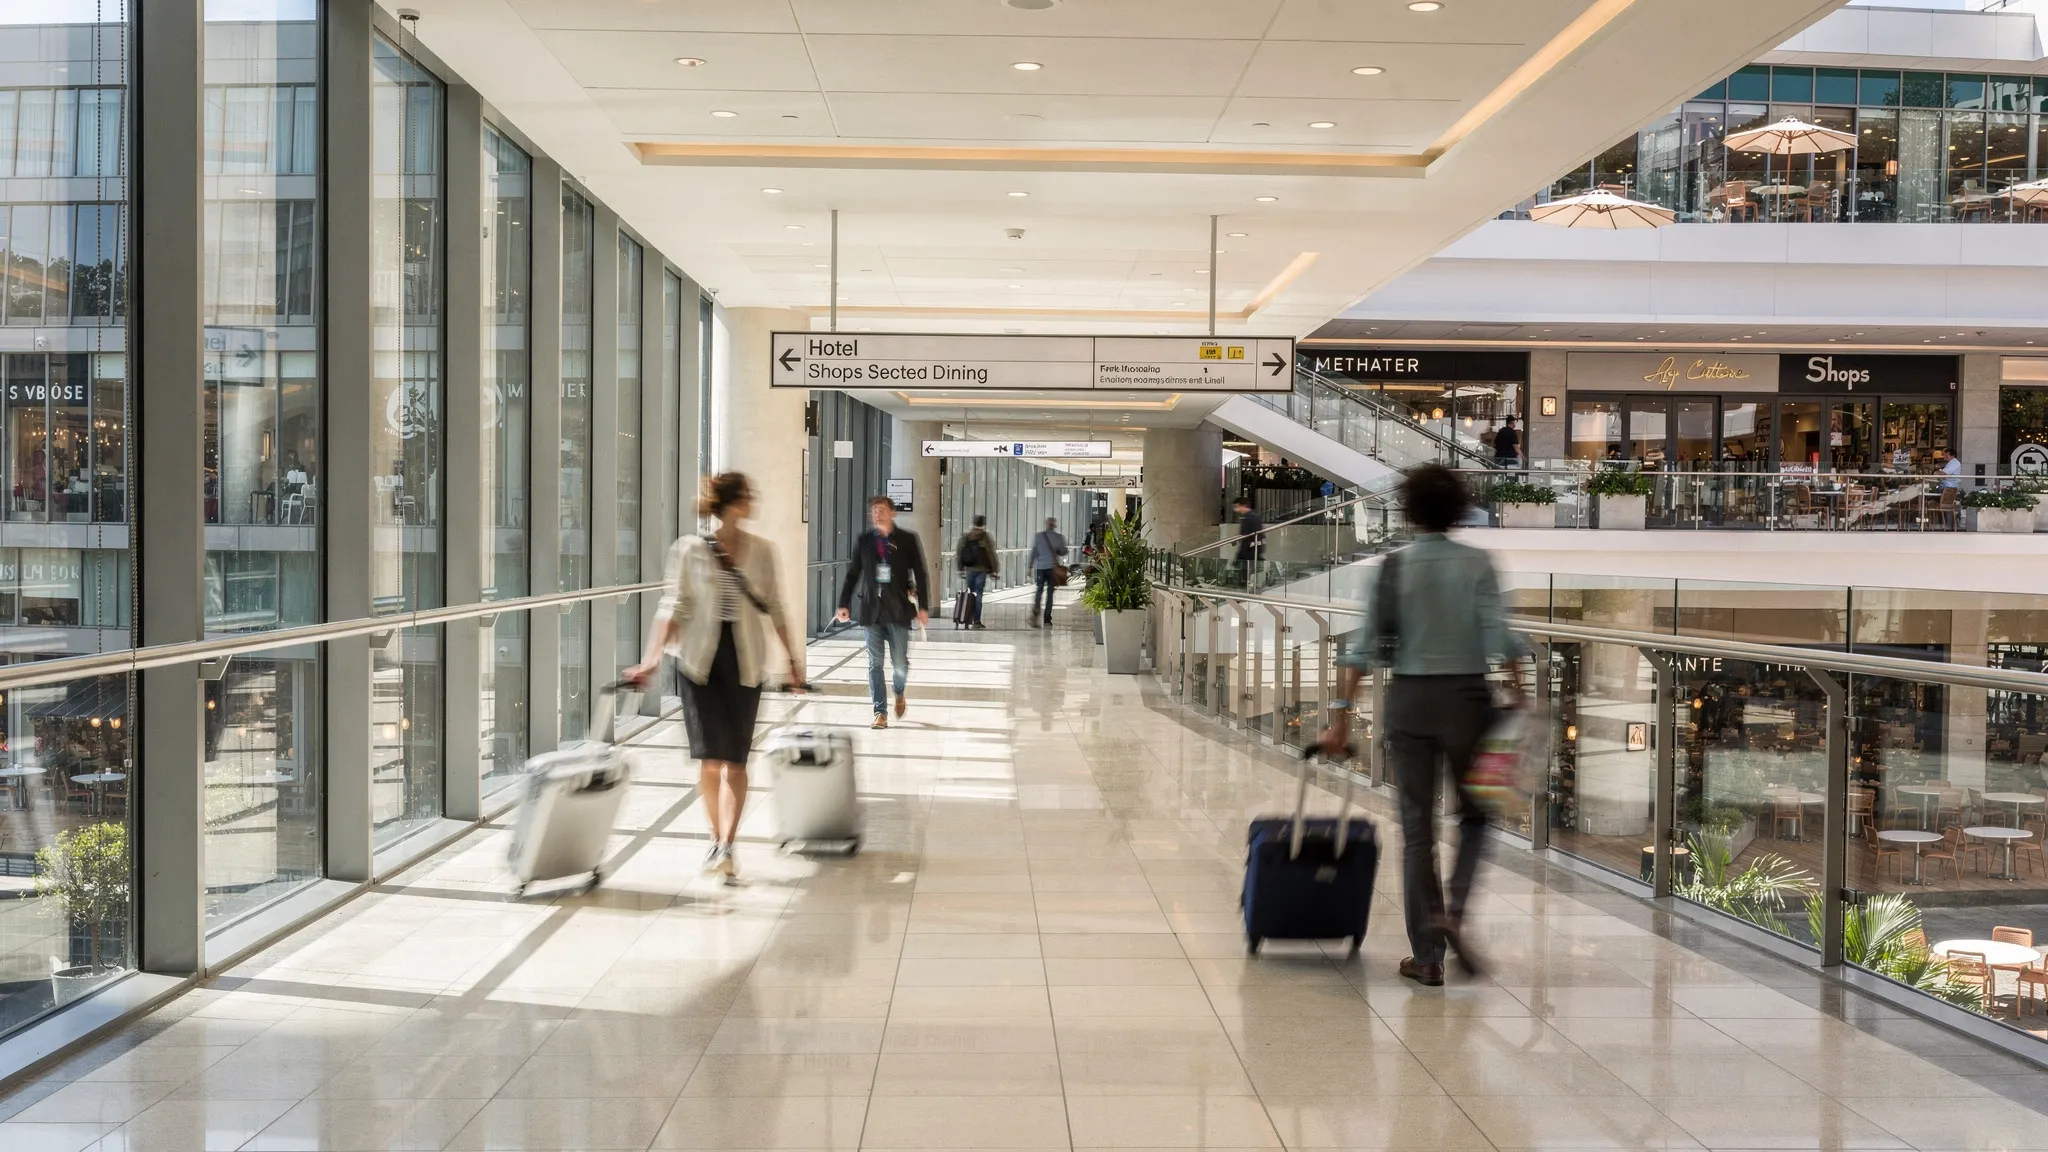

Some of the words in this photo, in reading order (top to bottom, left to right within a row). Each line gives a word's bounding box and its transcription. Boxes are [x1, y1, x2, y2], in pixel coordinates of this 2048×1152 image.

[808, 339, 858, 356] Hotel
[1315, 357, 1419, 372] METHATER
[808, 363, 863, 382] Shops
[867, 364, 928, 380] Sected
[932, 364, 988, 384] Dining
[1805, 356, 1870, 391] Shops
[1661, 657, 1723, 672] ANTE
